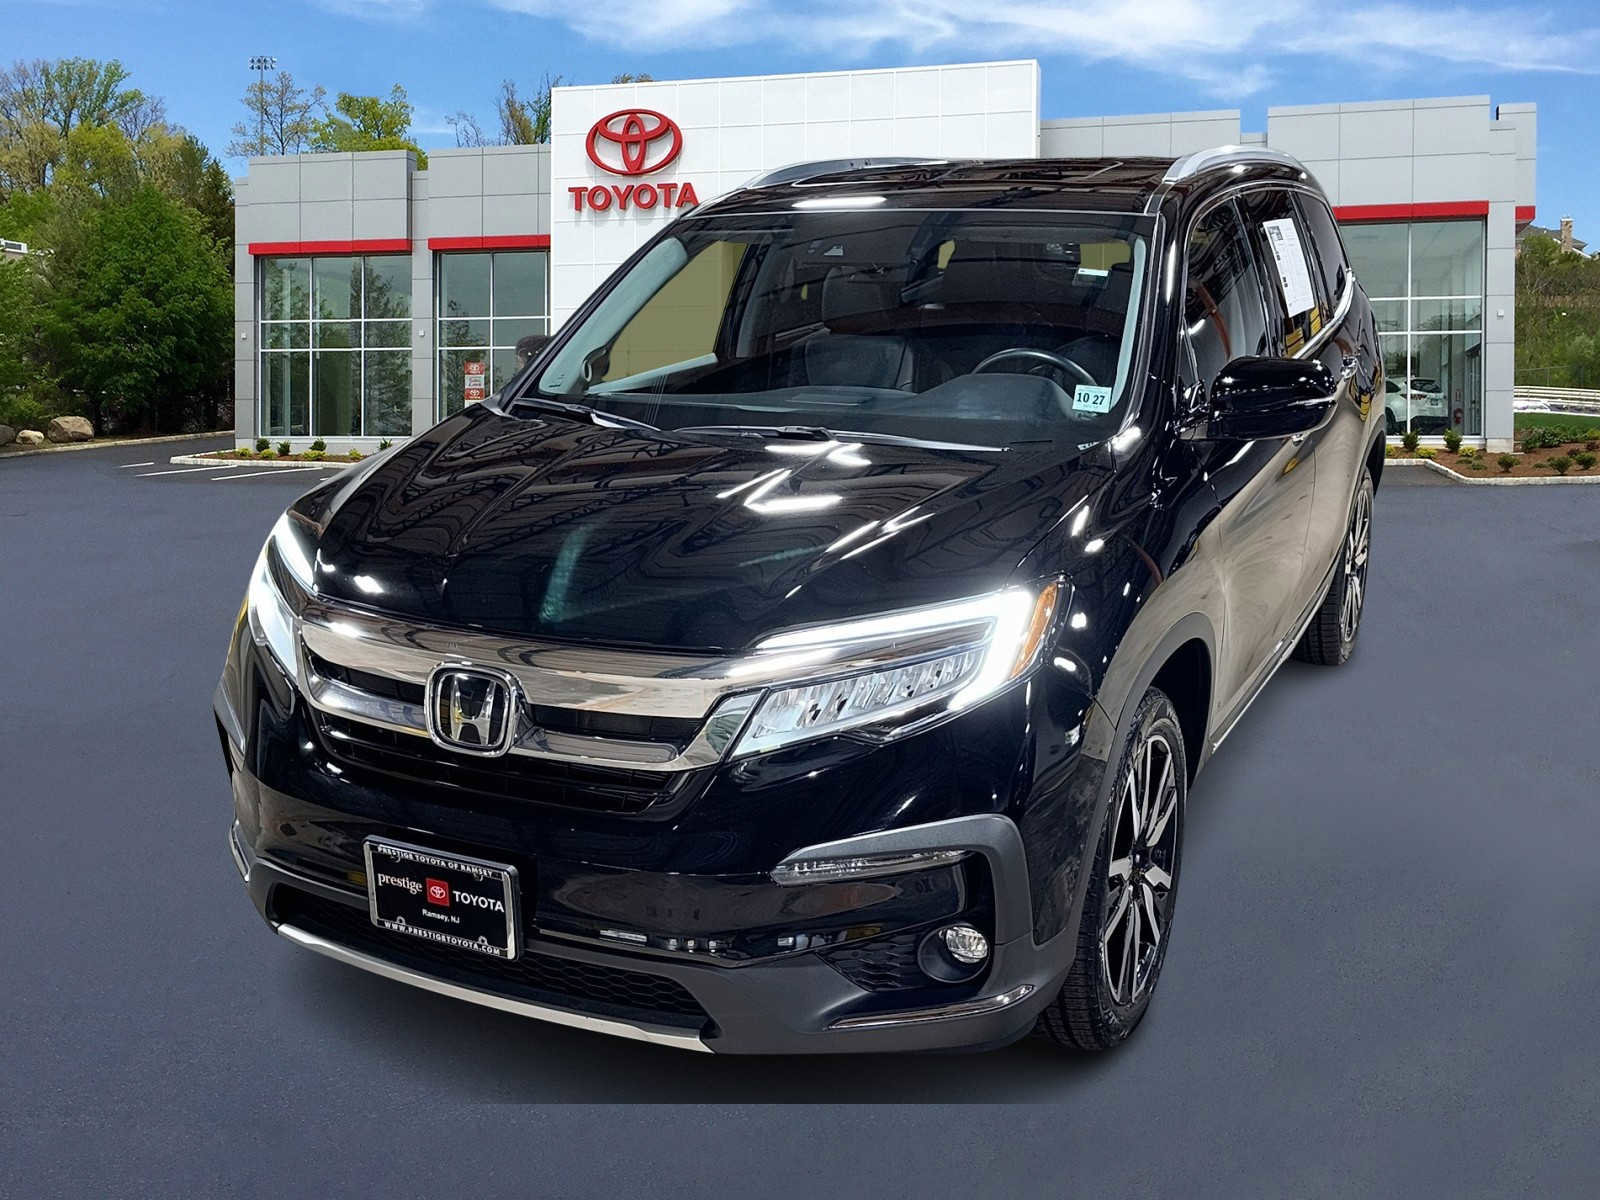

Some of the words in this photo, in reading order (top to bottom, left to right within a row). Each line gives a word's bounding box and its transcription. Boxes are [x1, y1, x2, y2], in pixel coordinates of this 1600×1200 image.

[568, 182, 699, 211] TOYOTA
[1077, 392, 1090, 403] 10
[1092, 394, 1105, 405] 27
[377, 846, 414, 860] PRESTIGE
[415, 854, 446, 867] TOYOTA
[448, 861, 459, 870] OF
[461, 864, 493, 878] RAMSEY
[377, 873, 423, 895] prestige
[452, 890, 505, 913] TOYOTA
[422, 908, 450, 922] Ramsey,
[450, 915, 460, 924] NJ
[384, 921, 500, 957] WWW.PRESTIGETOYOTA.COM
